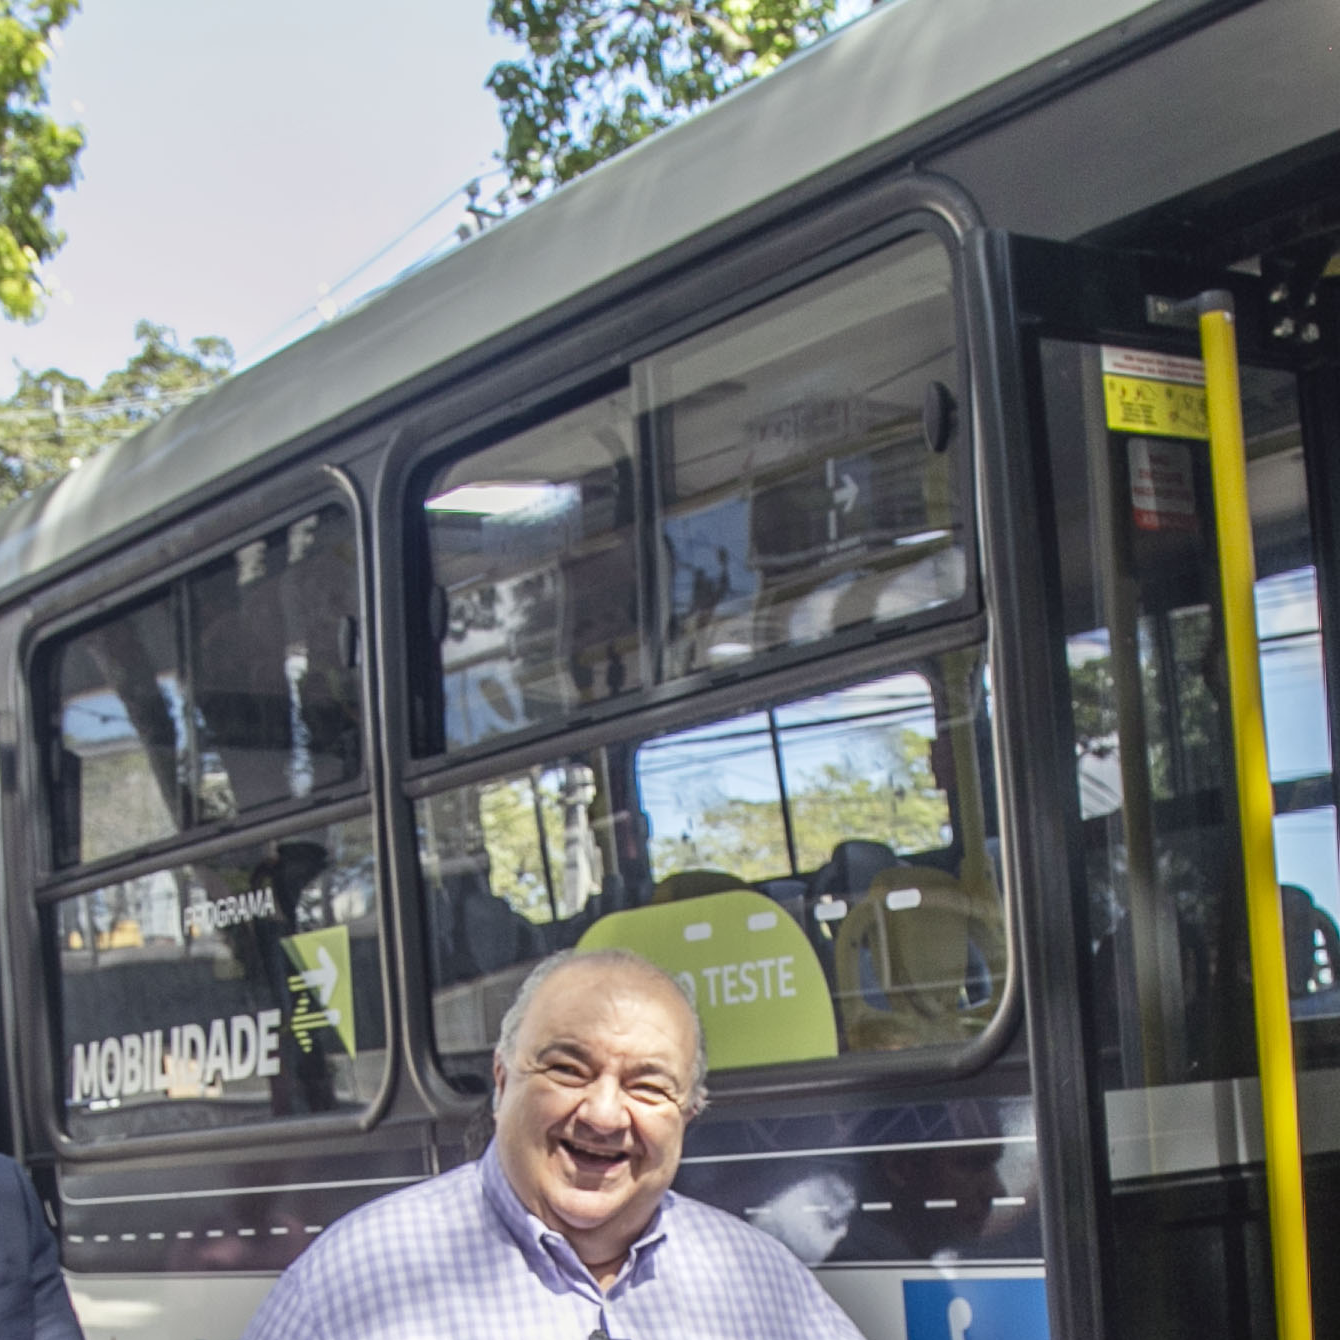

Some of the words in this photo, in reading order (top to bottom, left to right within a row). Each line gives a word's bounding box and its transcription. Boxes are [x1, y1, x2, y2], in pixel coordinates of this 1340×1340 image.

[183, 886, 277, 938] PROGRAMA
[701, 955, 797, 1007] TESTE
[71, 1008, 282, 1103] MOBILIDADE
